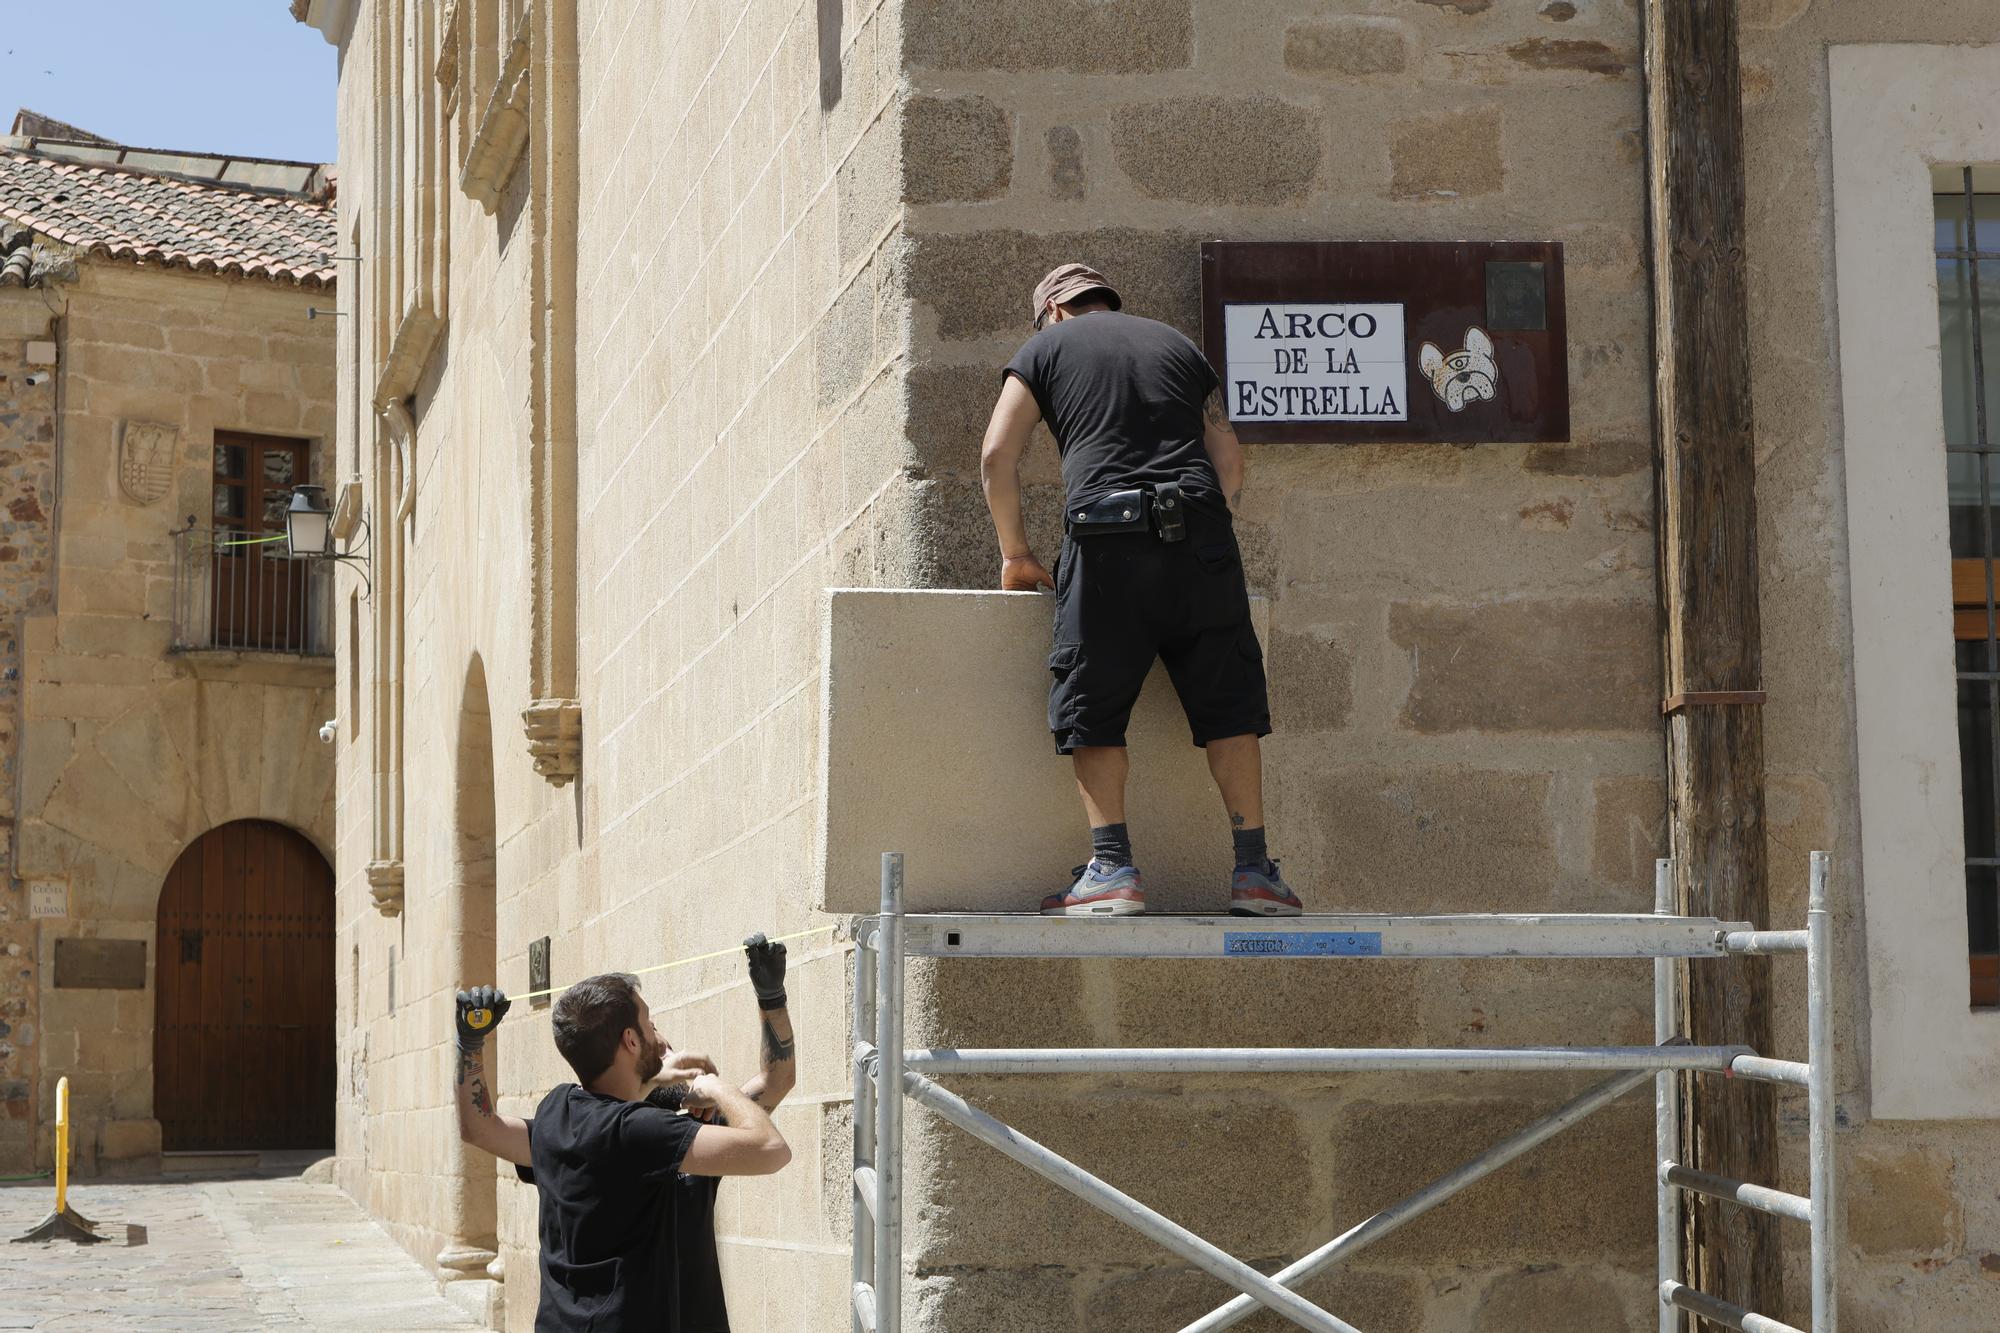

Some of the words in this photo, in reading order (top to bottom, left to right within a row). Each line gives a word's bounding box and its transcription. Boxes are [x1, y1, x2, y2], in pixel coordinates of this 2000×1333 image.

[1254, 307, 1377, 339] ARCO
[1274, 348, 1308, 374] DE
[1326, 348, 1360, 374] LA
[1235, 381, 1400, 417] ESTRELLA
